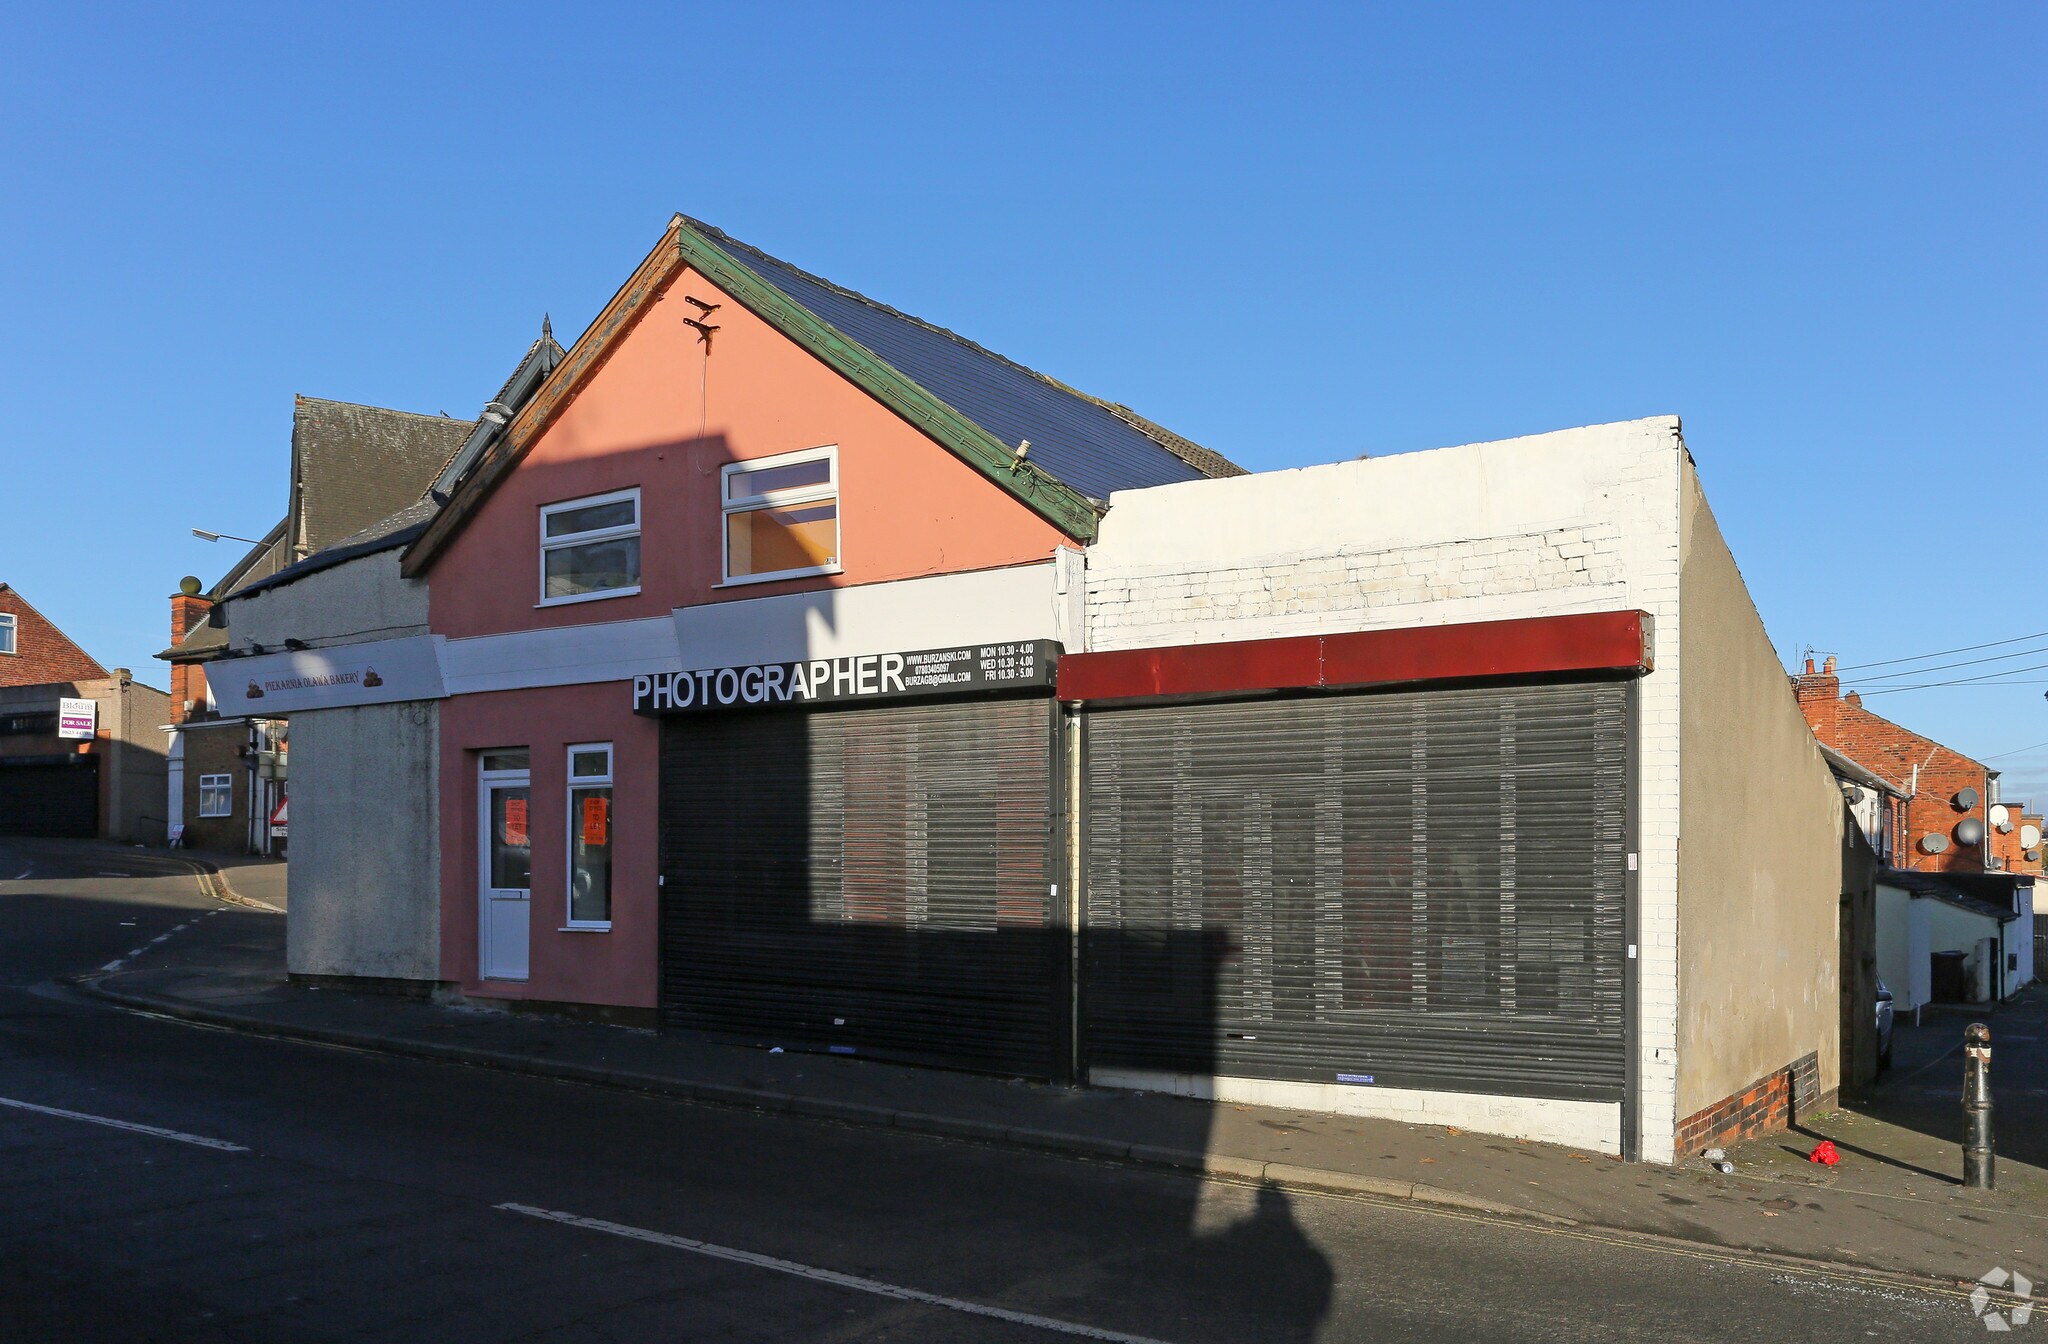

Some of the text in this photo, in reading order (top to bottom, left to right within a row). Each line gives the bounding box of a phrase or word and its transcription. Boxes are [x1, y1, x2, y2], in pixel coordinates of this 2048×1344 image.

[906, 650, 971, 665] WWW.BURZANSKI.COM
[981, 646, 996, 658] MON
[998, 645, 1015, 656] 10.30
[1020, 643, 1034, 654] 4.00
[980, 659, 996, 670] WED
[998, 657, 1015, 668] 10.30
[1020, 655, 1034, 666] 4.00
[265, 678, 303, 692] PIEKARNIA
[329, 670, 360, 686] BAKERY
[633, 653, 907, 710] PHOTOGRAPHER
[905, 671, 971, 687] BURZAGB@GMAIL.COM
[985, 670, 996, 681] FRI
[998, 668, 1015, 680] 10.30
[1020, 667, 1034, 678] 5.00
